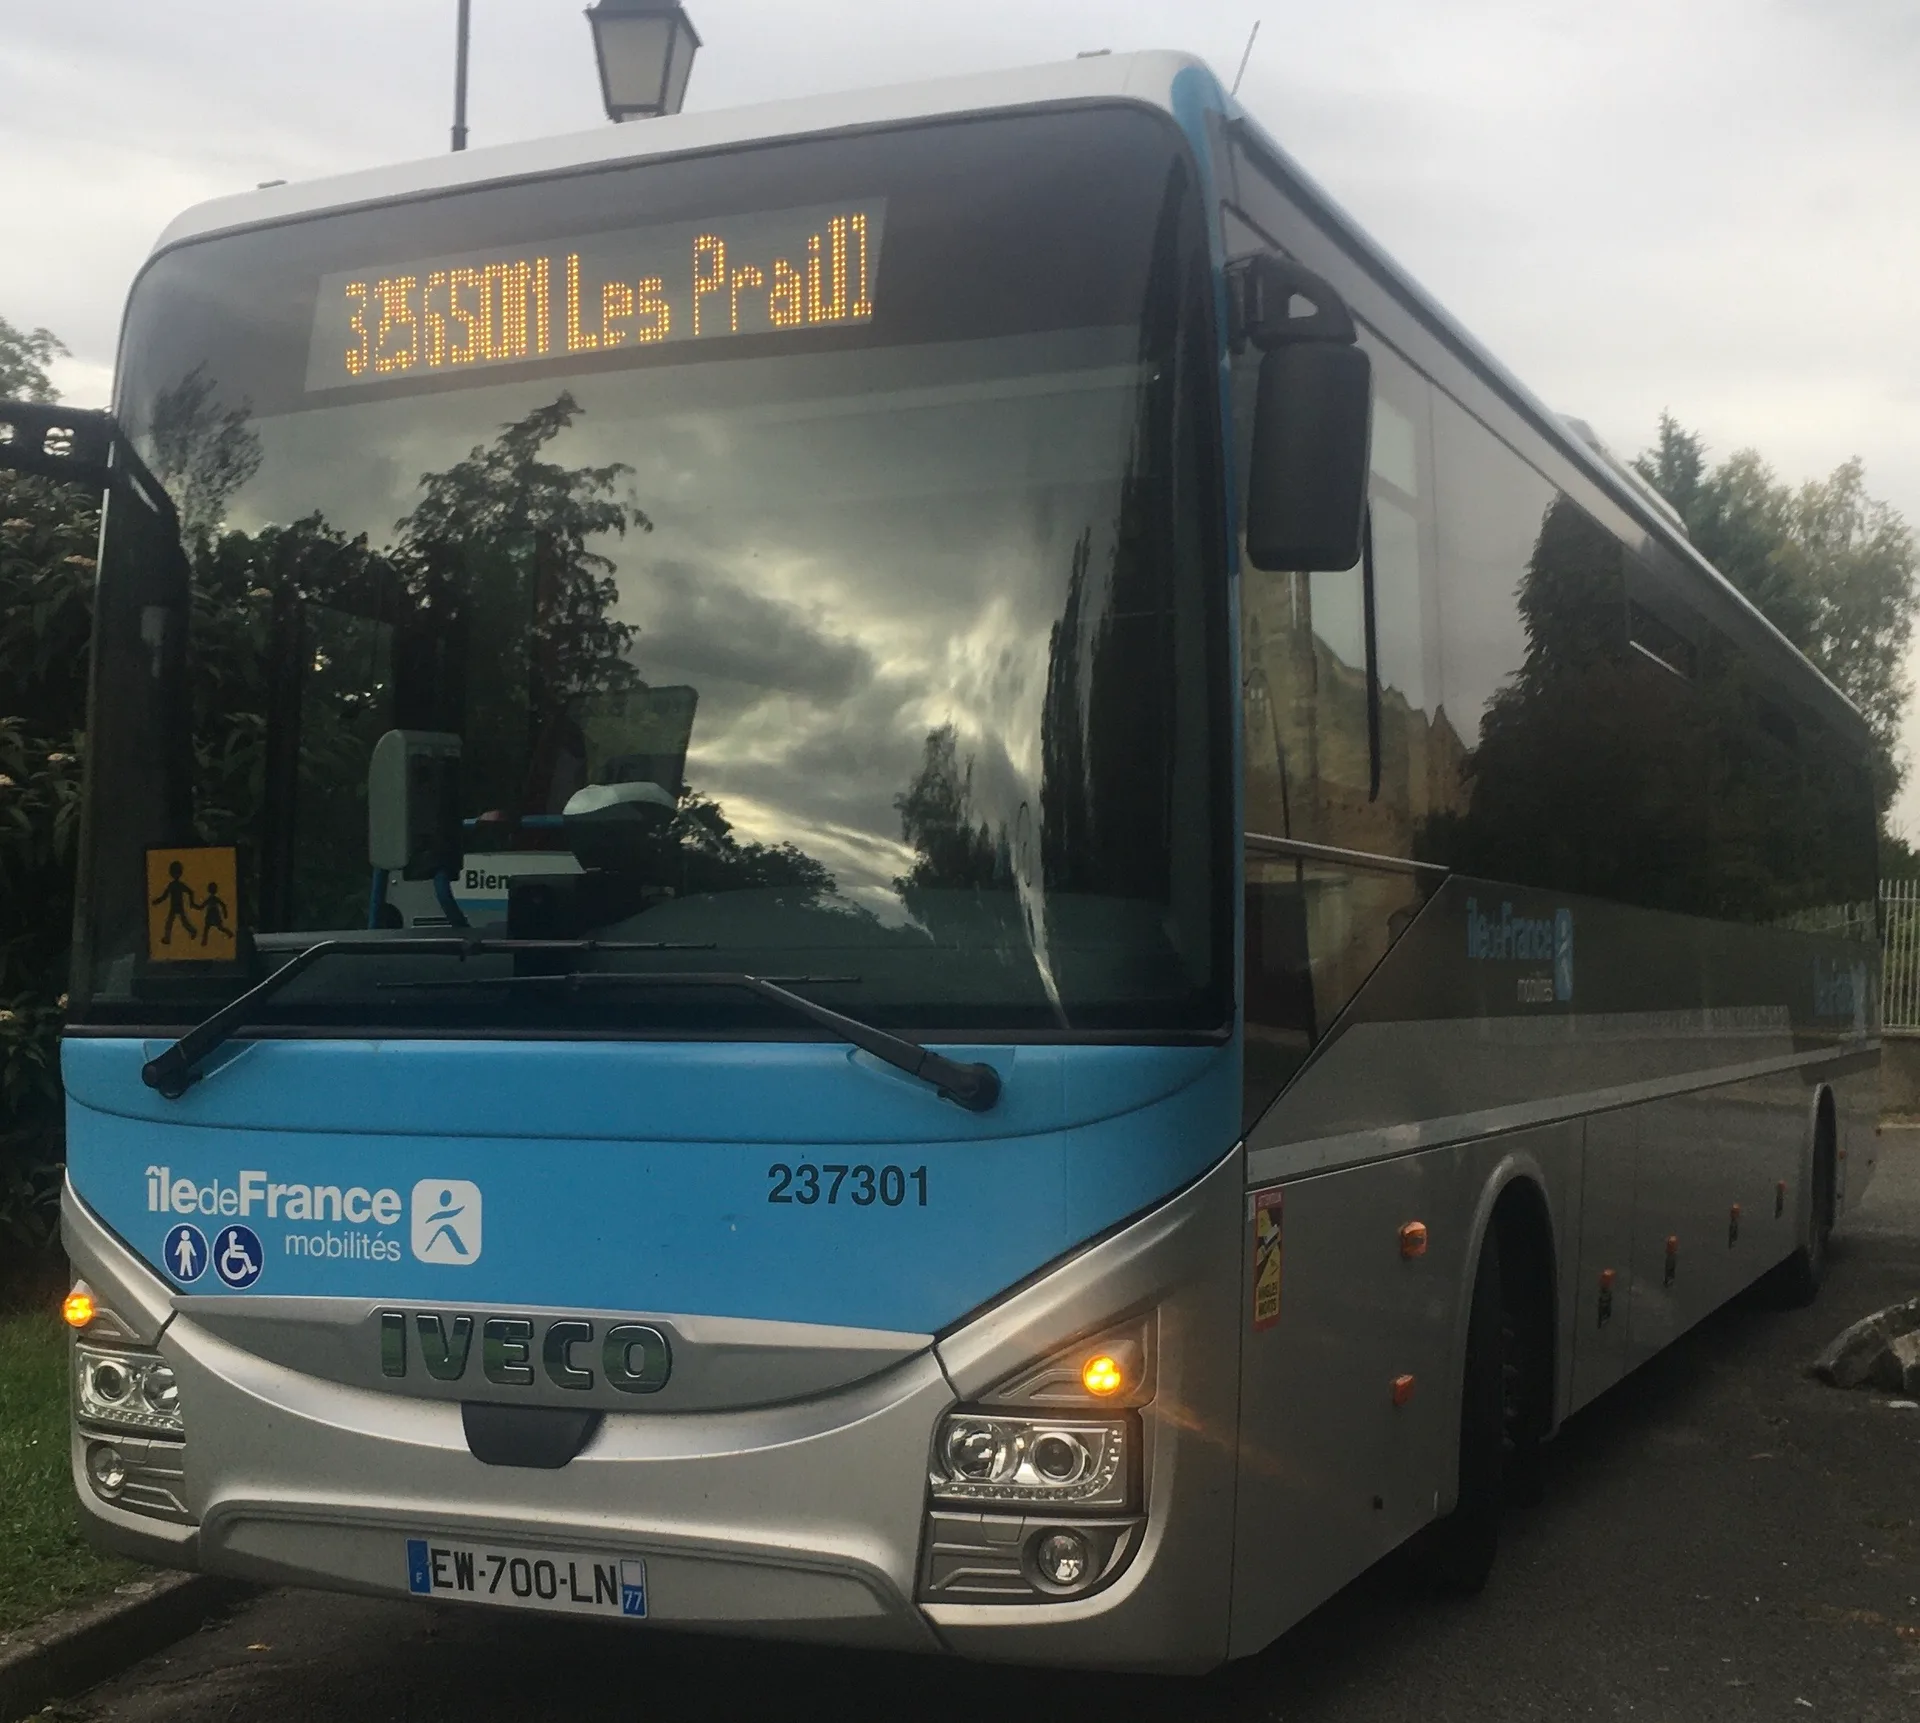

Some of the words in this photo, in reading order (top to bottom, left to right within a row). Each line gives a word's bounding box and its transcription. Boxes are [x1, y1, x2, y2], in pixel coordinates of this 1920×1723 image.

[567, 253, 671, 351] Les
[767, 1163, 928, 1207] 237301
[285, 1230, 401, 1262] mobilités
[381, 1310, 673, 1395] IVECO
[430, 1547, 619, 1606] EW-700-LN
[623, 1589, 643, 1612] 77
